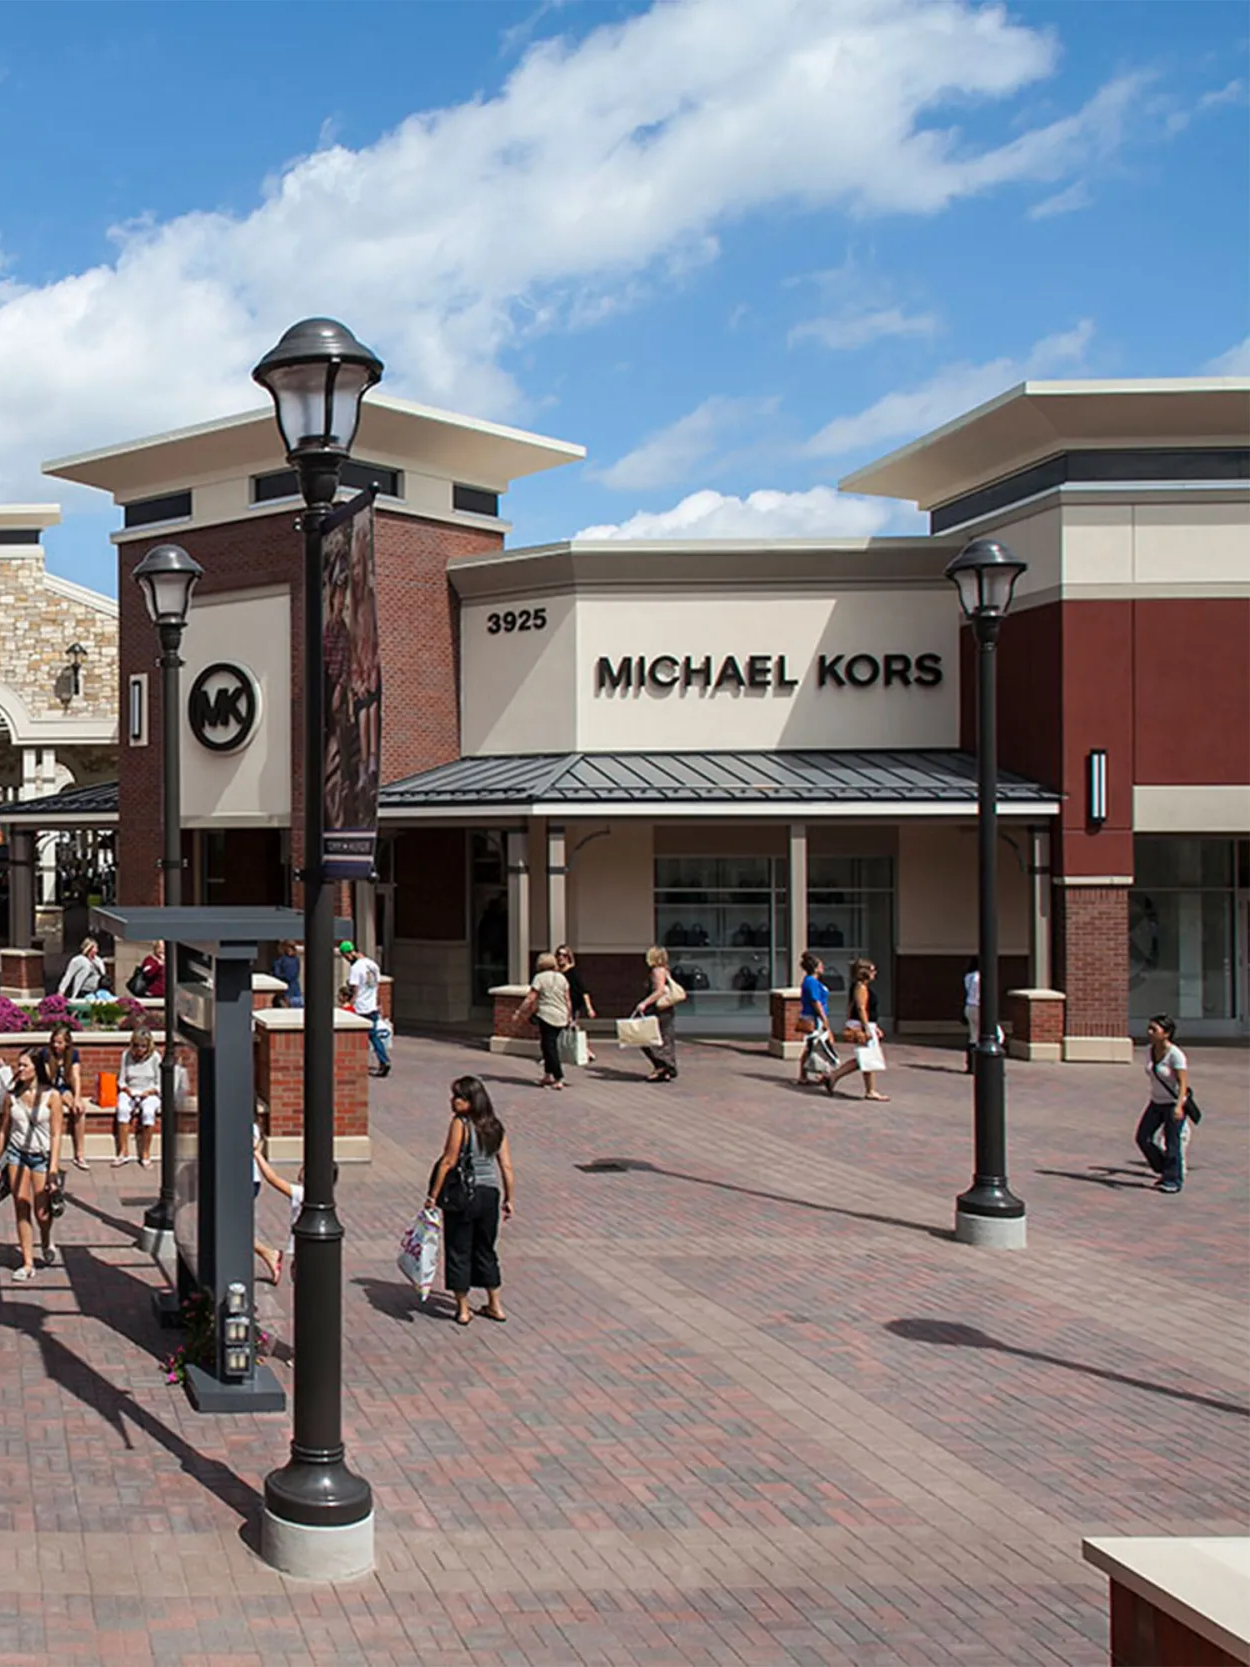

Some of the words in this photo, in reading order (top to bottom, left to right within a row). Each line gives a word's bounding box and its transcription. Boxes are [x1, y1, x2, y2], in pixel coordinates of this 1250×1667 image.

[487, 607, 547, 634] 3925
[595, 654, 798, 690] MICHAEL
[816, 653, 943, 688] KORS
[195, 686, 248, 729] MK
